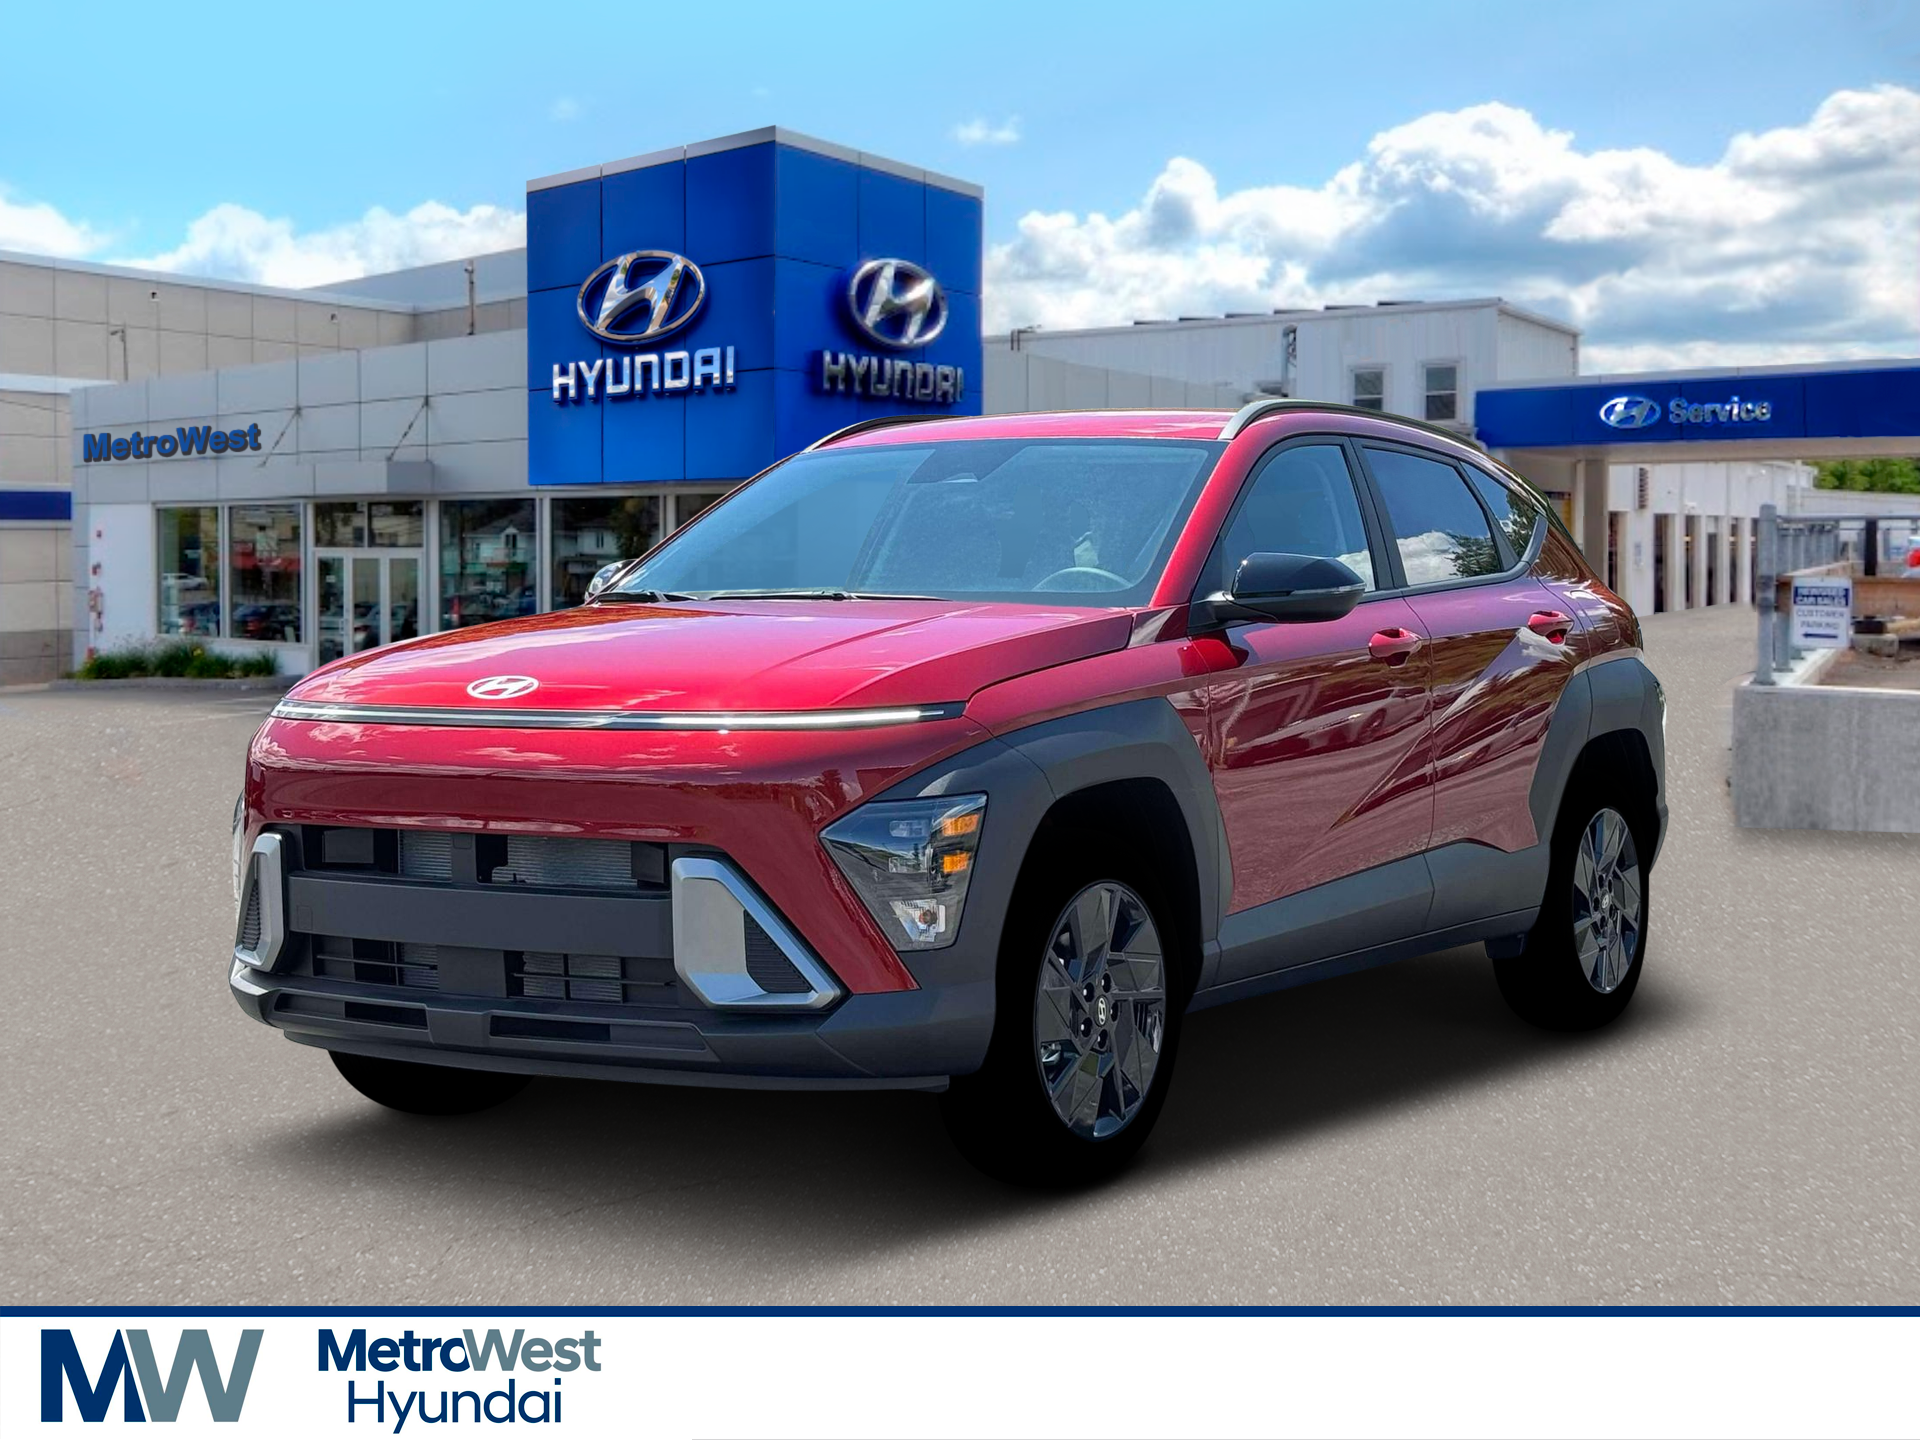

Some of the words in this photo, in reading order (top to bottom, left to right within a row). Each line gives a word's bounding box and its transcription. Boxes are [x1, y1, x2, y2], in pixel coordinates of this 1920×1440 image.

[553, 345, 735, 402] HYUNDAI
[823, 350, 965, 403] HYUNDAI
[1669, 395, 1771, 424] Service
[84, 423, 261, 462] MetroWest
[1796, 597, 1816, 606] CAR
[1796, 609, 1845, 618] CUSTOMER
[1800, 620, 1840, 630] PARKING
